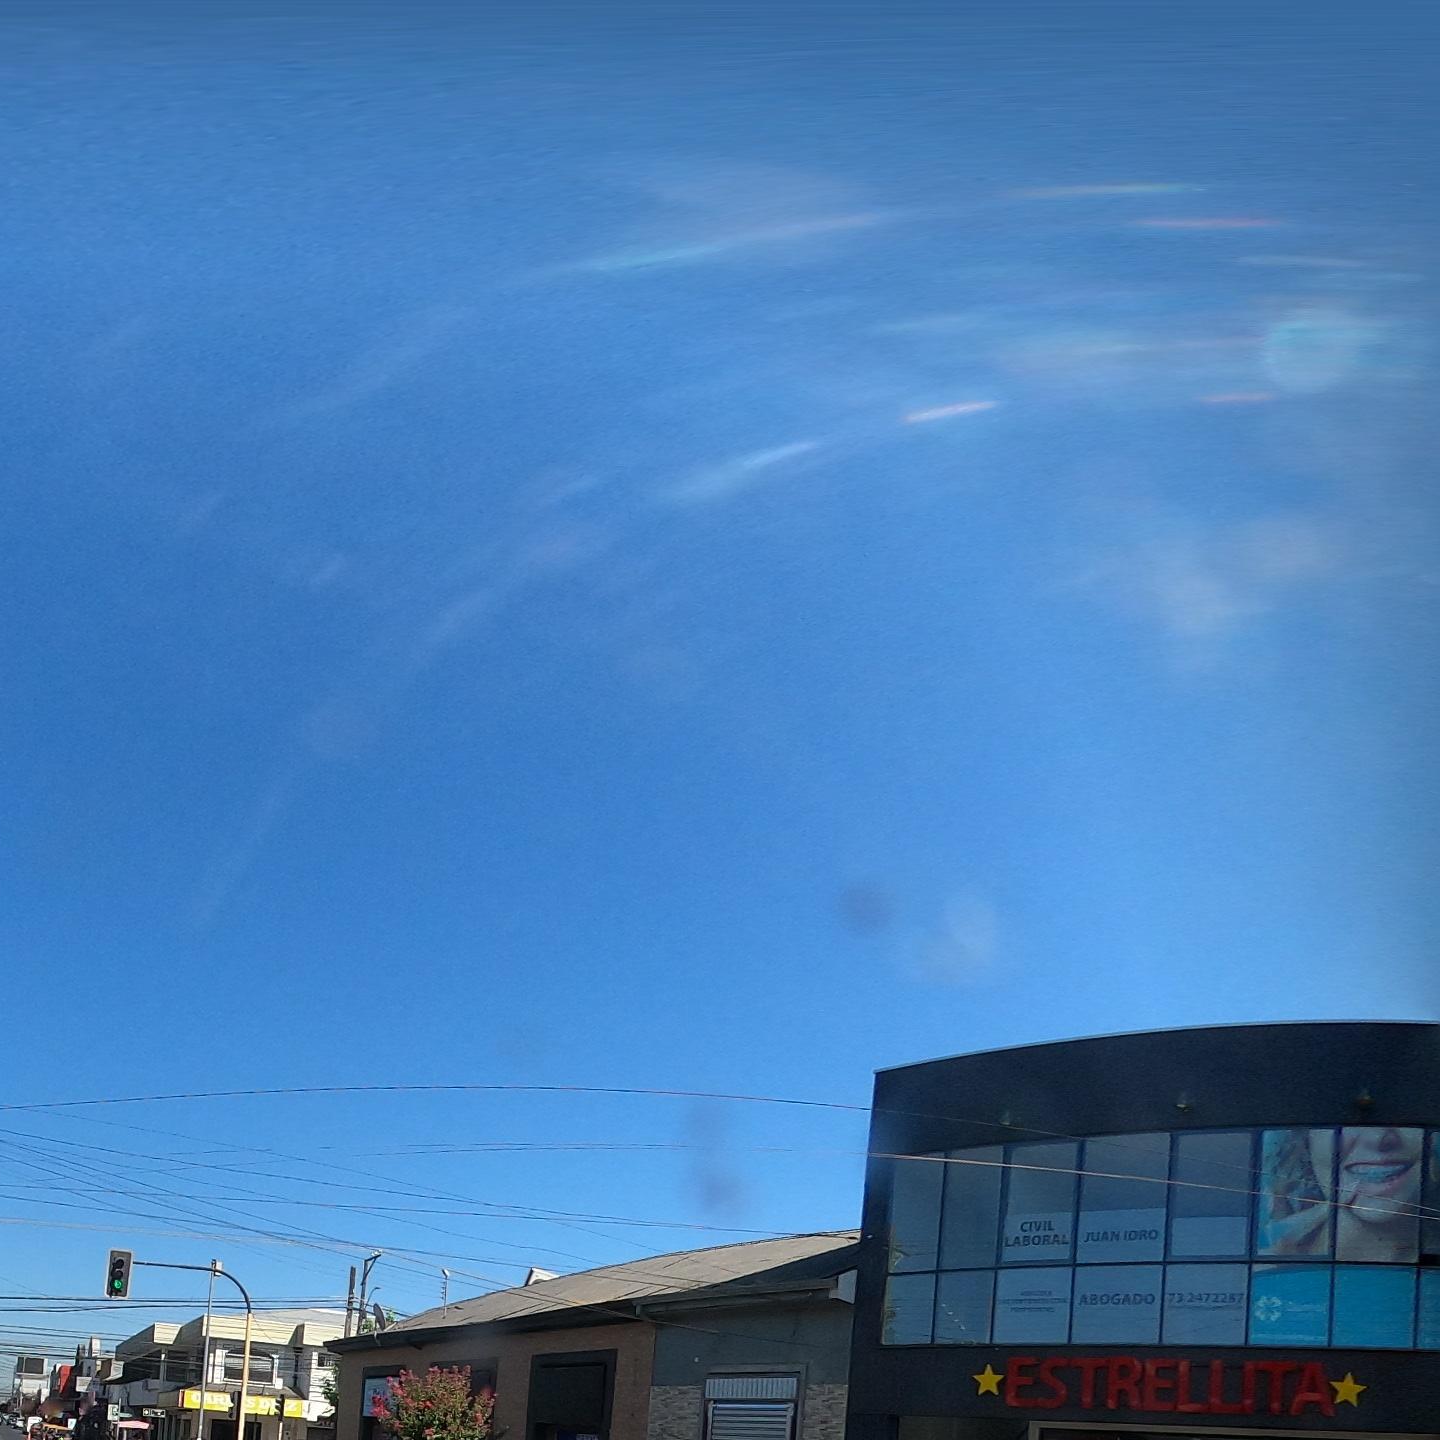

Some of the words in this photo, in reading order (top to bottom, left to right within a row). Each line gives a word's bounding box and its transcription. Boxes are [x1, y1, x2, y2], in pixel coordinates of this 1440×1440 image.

[1020, 1220, 1055, 1232] CIVIL
[1004, 1234, 1069, 1247] LABORAL
[1083, 1231, 1120, 1243] JUAN
[1078, 1293, 1156, 1306] ABOGADO
[1004, 1357, 1337, 1417] ESTRELLITA
